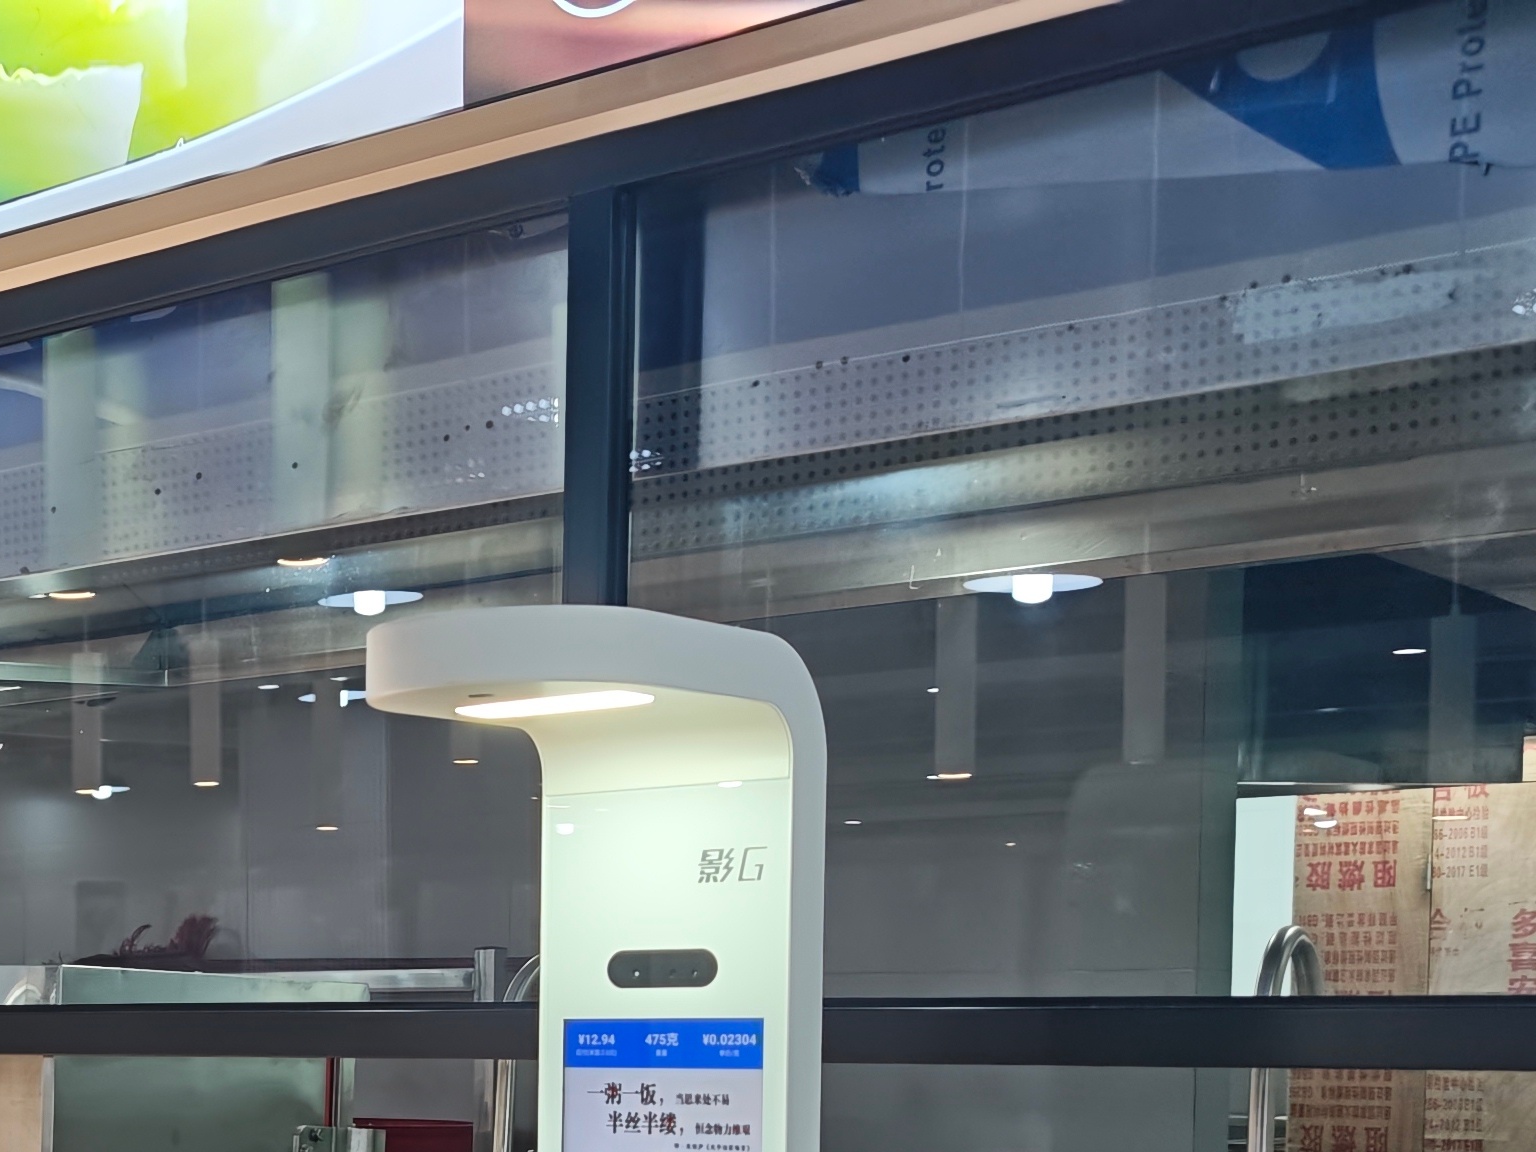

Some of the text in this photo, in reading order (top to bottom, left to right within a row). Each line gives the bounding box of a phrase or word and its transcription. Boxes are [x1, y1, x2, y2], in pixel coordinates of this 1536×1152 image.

[578, 1033, 757, 1046] ¥12.94 475克 ¥0.02304
